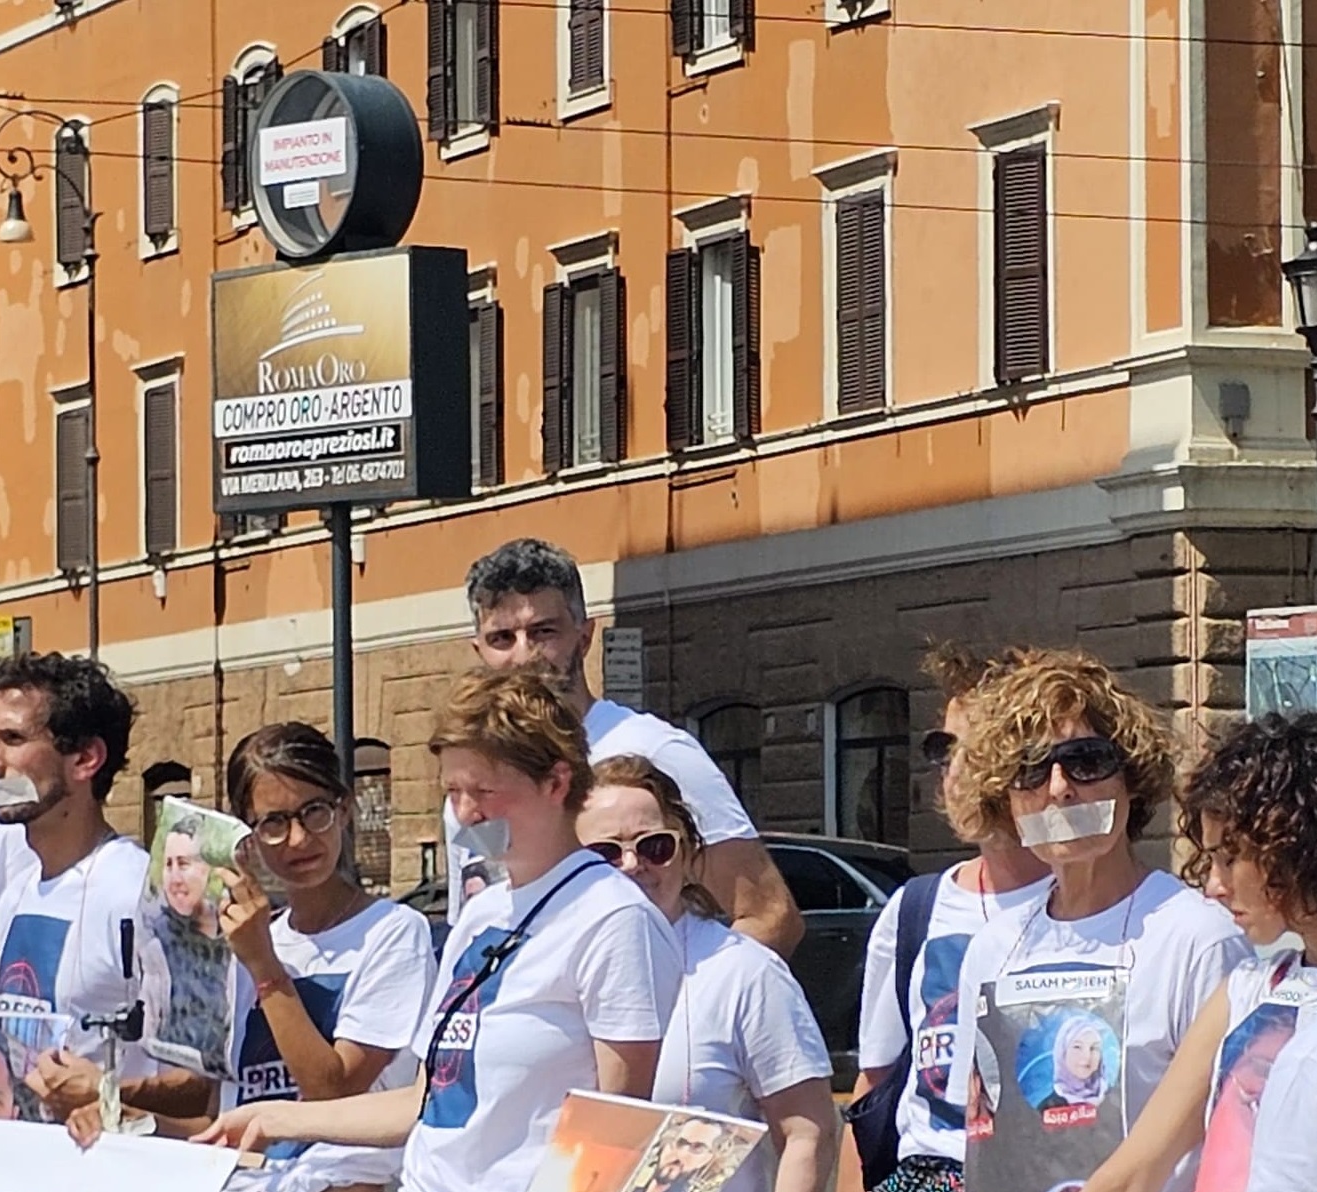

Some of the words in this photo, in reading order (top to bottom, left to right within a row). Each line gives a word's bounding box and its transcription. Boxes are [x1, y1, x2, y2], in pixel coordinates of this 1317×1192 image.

[273, 134, 320, 151] IMPIANTO
[322, 132, 333, 143] IN
[264, 151, 342, 171] MANUTENZIONE
[222, 399, 285, 431] COMPRO
[290, 395, 321, 424] ORO
[229, 427, 395, 464] romaoroepreziosi.it
[221, 477, 239, 496] VIA
[239, 470, 302, 492] MERULANA,
[1015, 977, 1059, 991] SALAM
